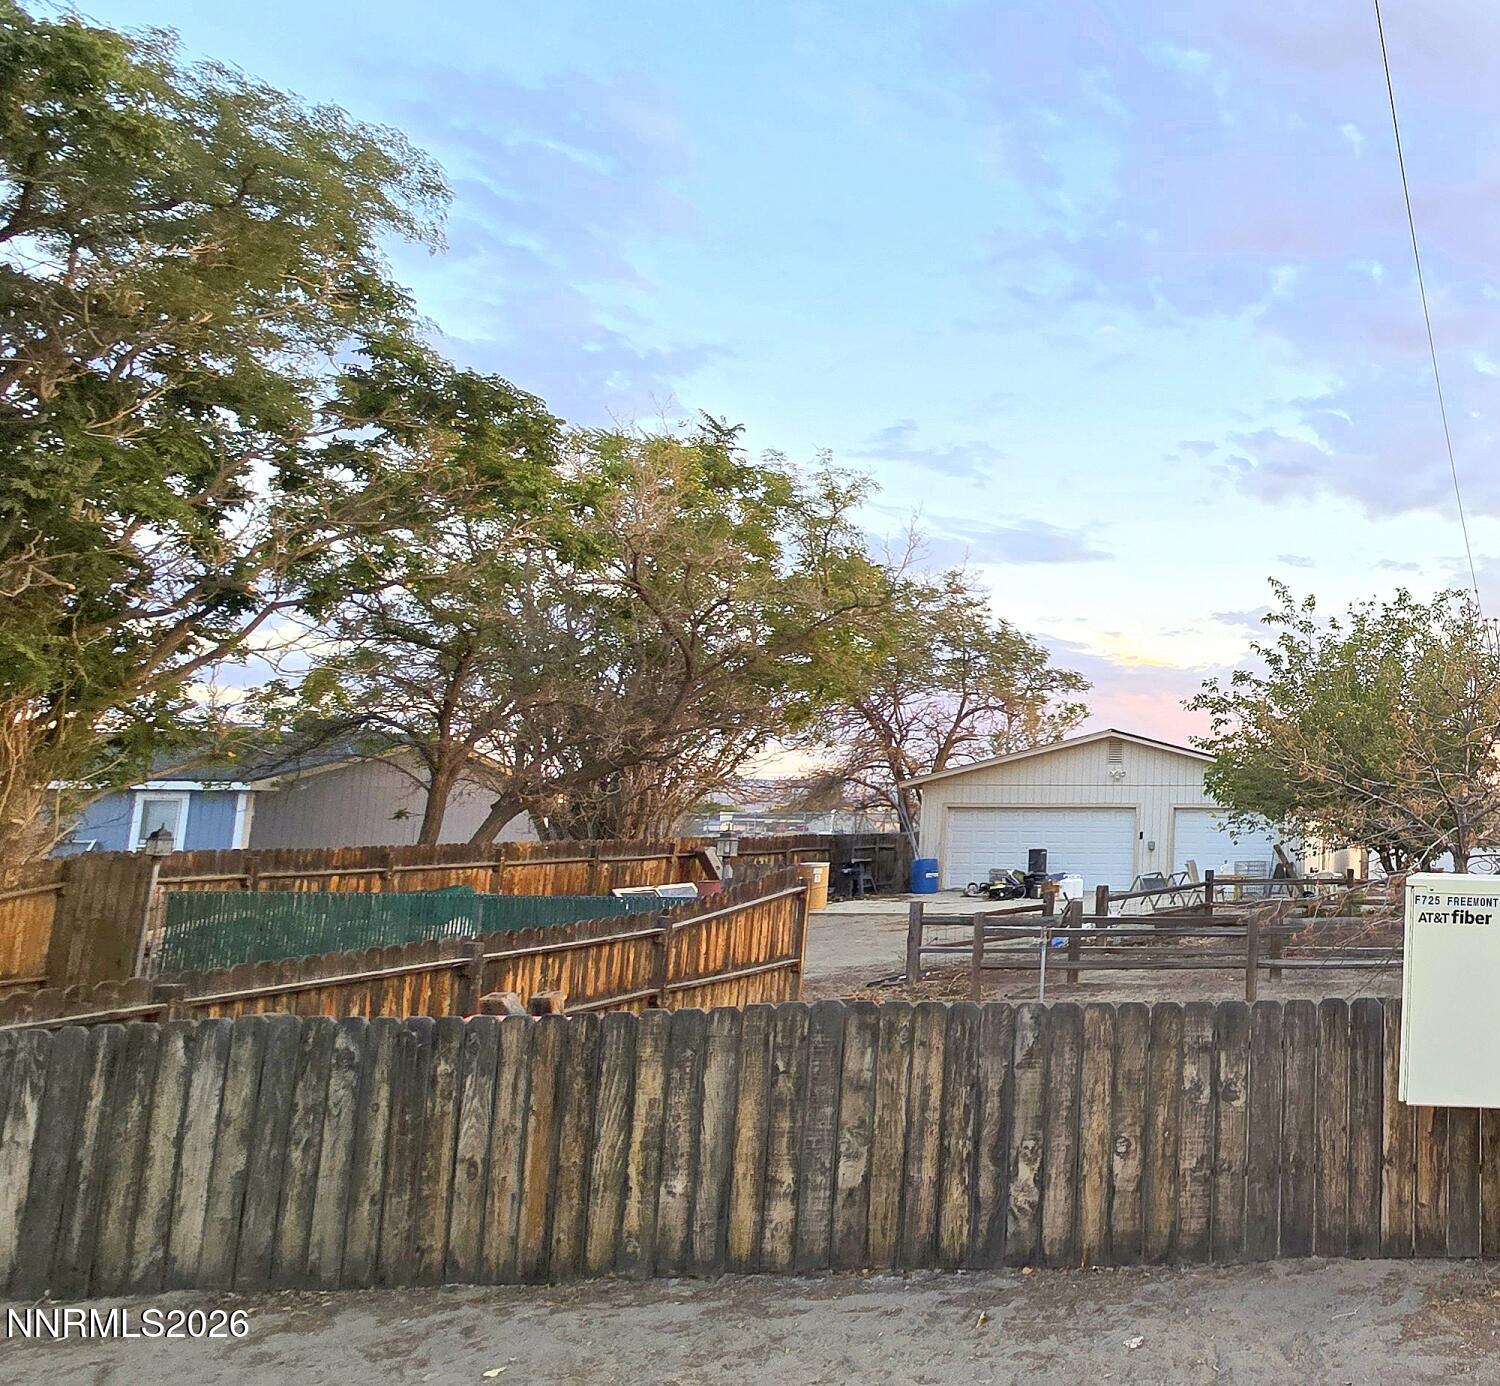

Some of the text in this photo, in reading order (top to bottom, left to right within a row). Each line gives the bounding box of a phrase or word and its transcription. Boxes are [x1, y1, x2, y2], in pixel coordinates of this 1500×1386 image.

[1415, 895, 1499, 907] F725 FREEMONT
[1418, 909, 1492, 925] AT&T fiber
